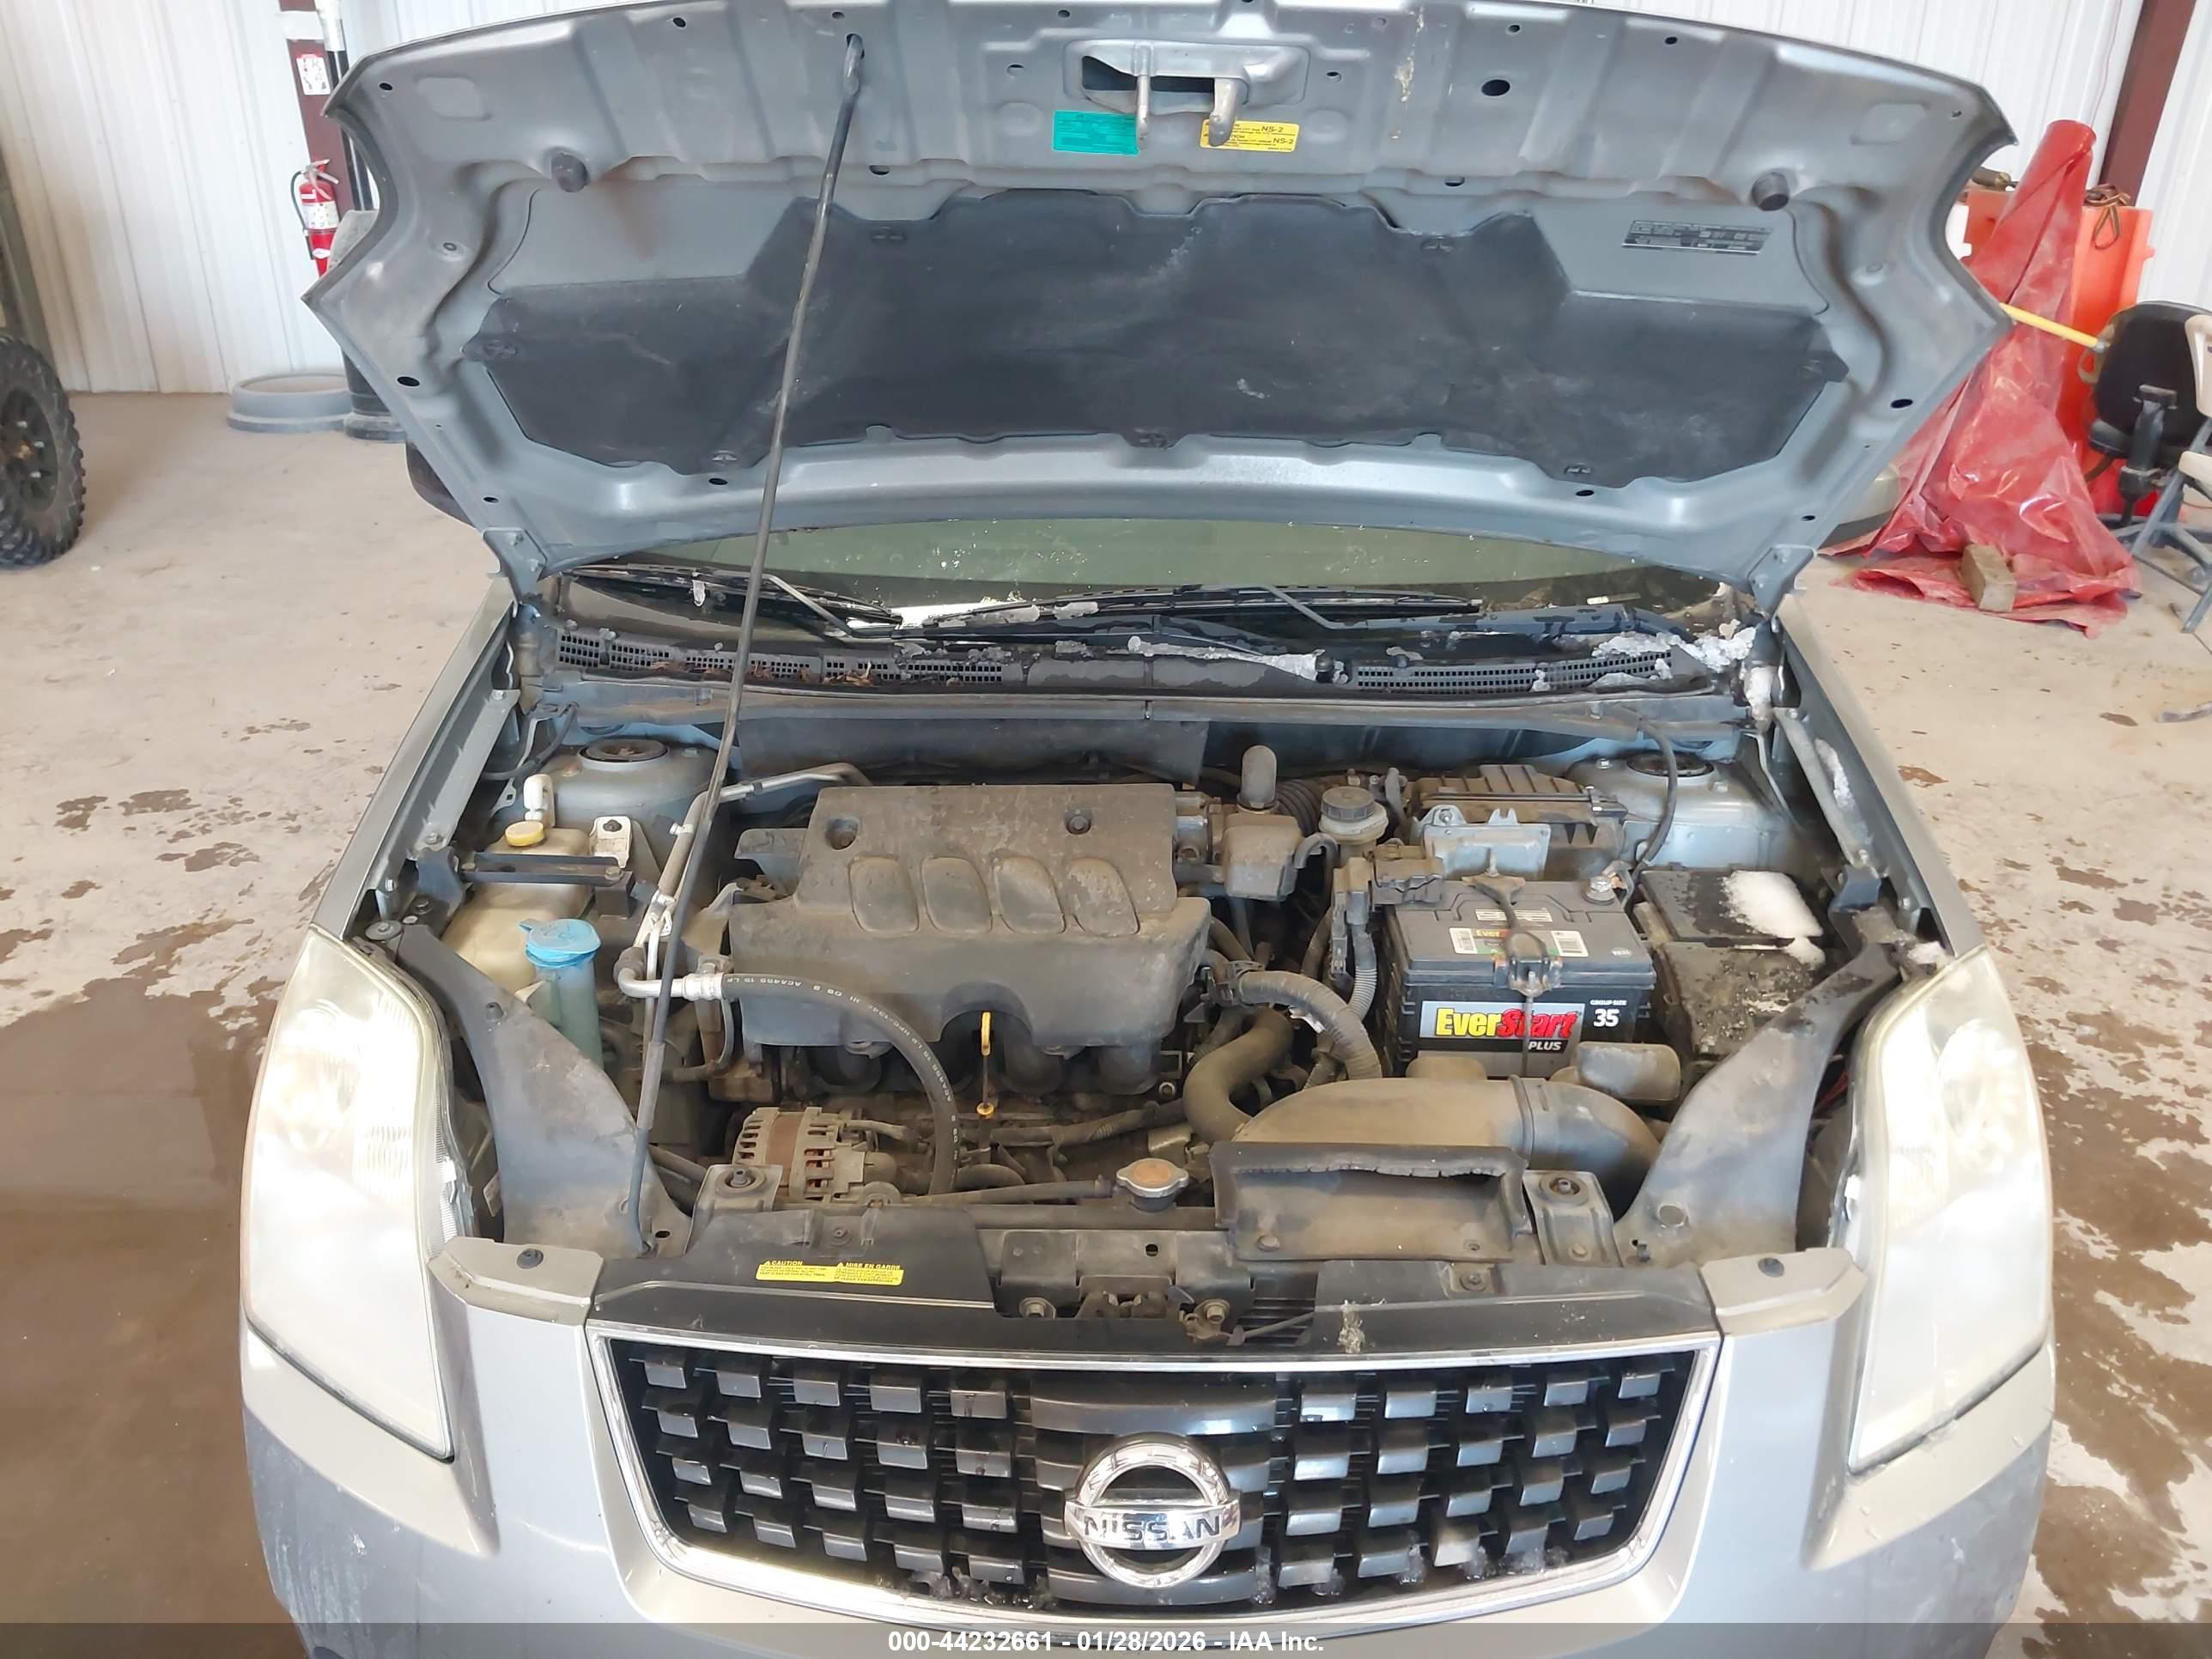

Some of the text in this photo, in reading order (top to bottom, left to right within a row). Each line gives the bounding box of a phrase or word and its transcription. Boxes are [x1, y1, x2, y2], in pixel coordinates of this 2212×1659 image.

[1435, 1007, 1578, 1038] EverStart
[1593, 1008, 1620, 1027] 35
[1528, 1041, 1563, 1051] PLUS
[1083, 1516, 1221, 1541] NISSAN
